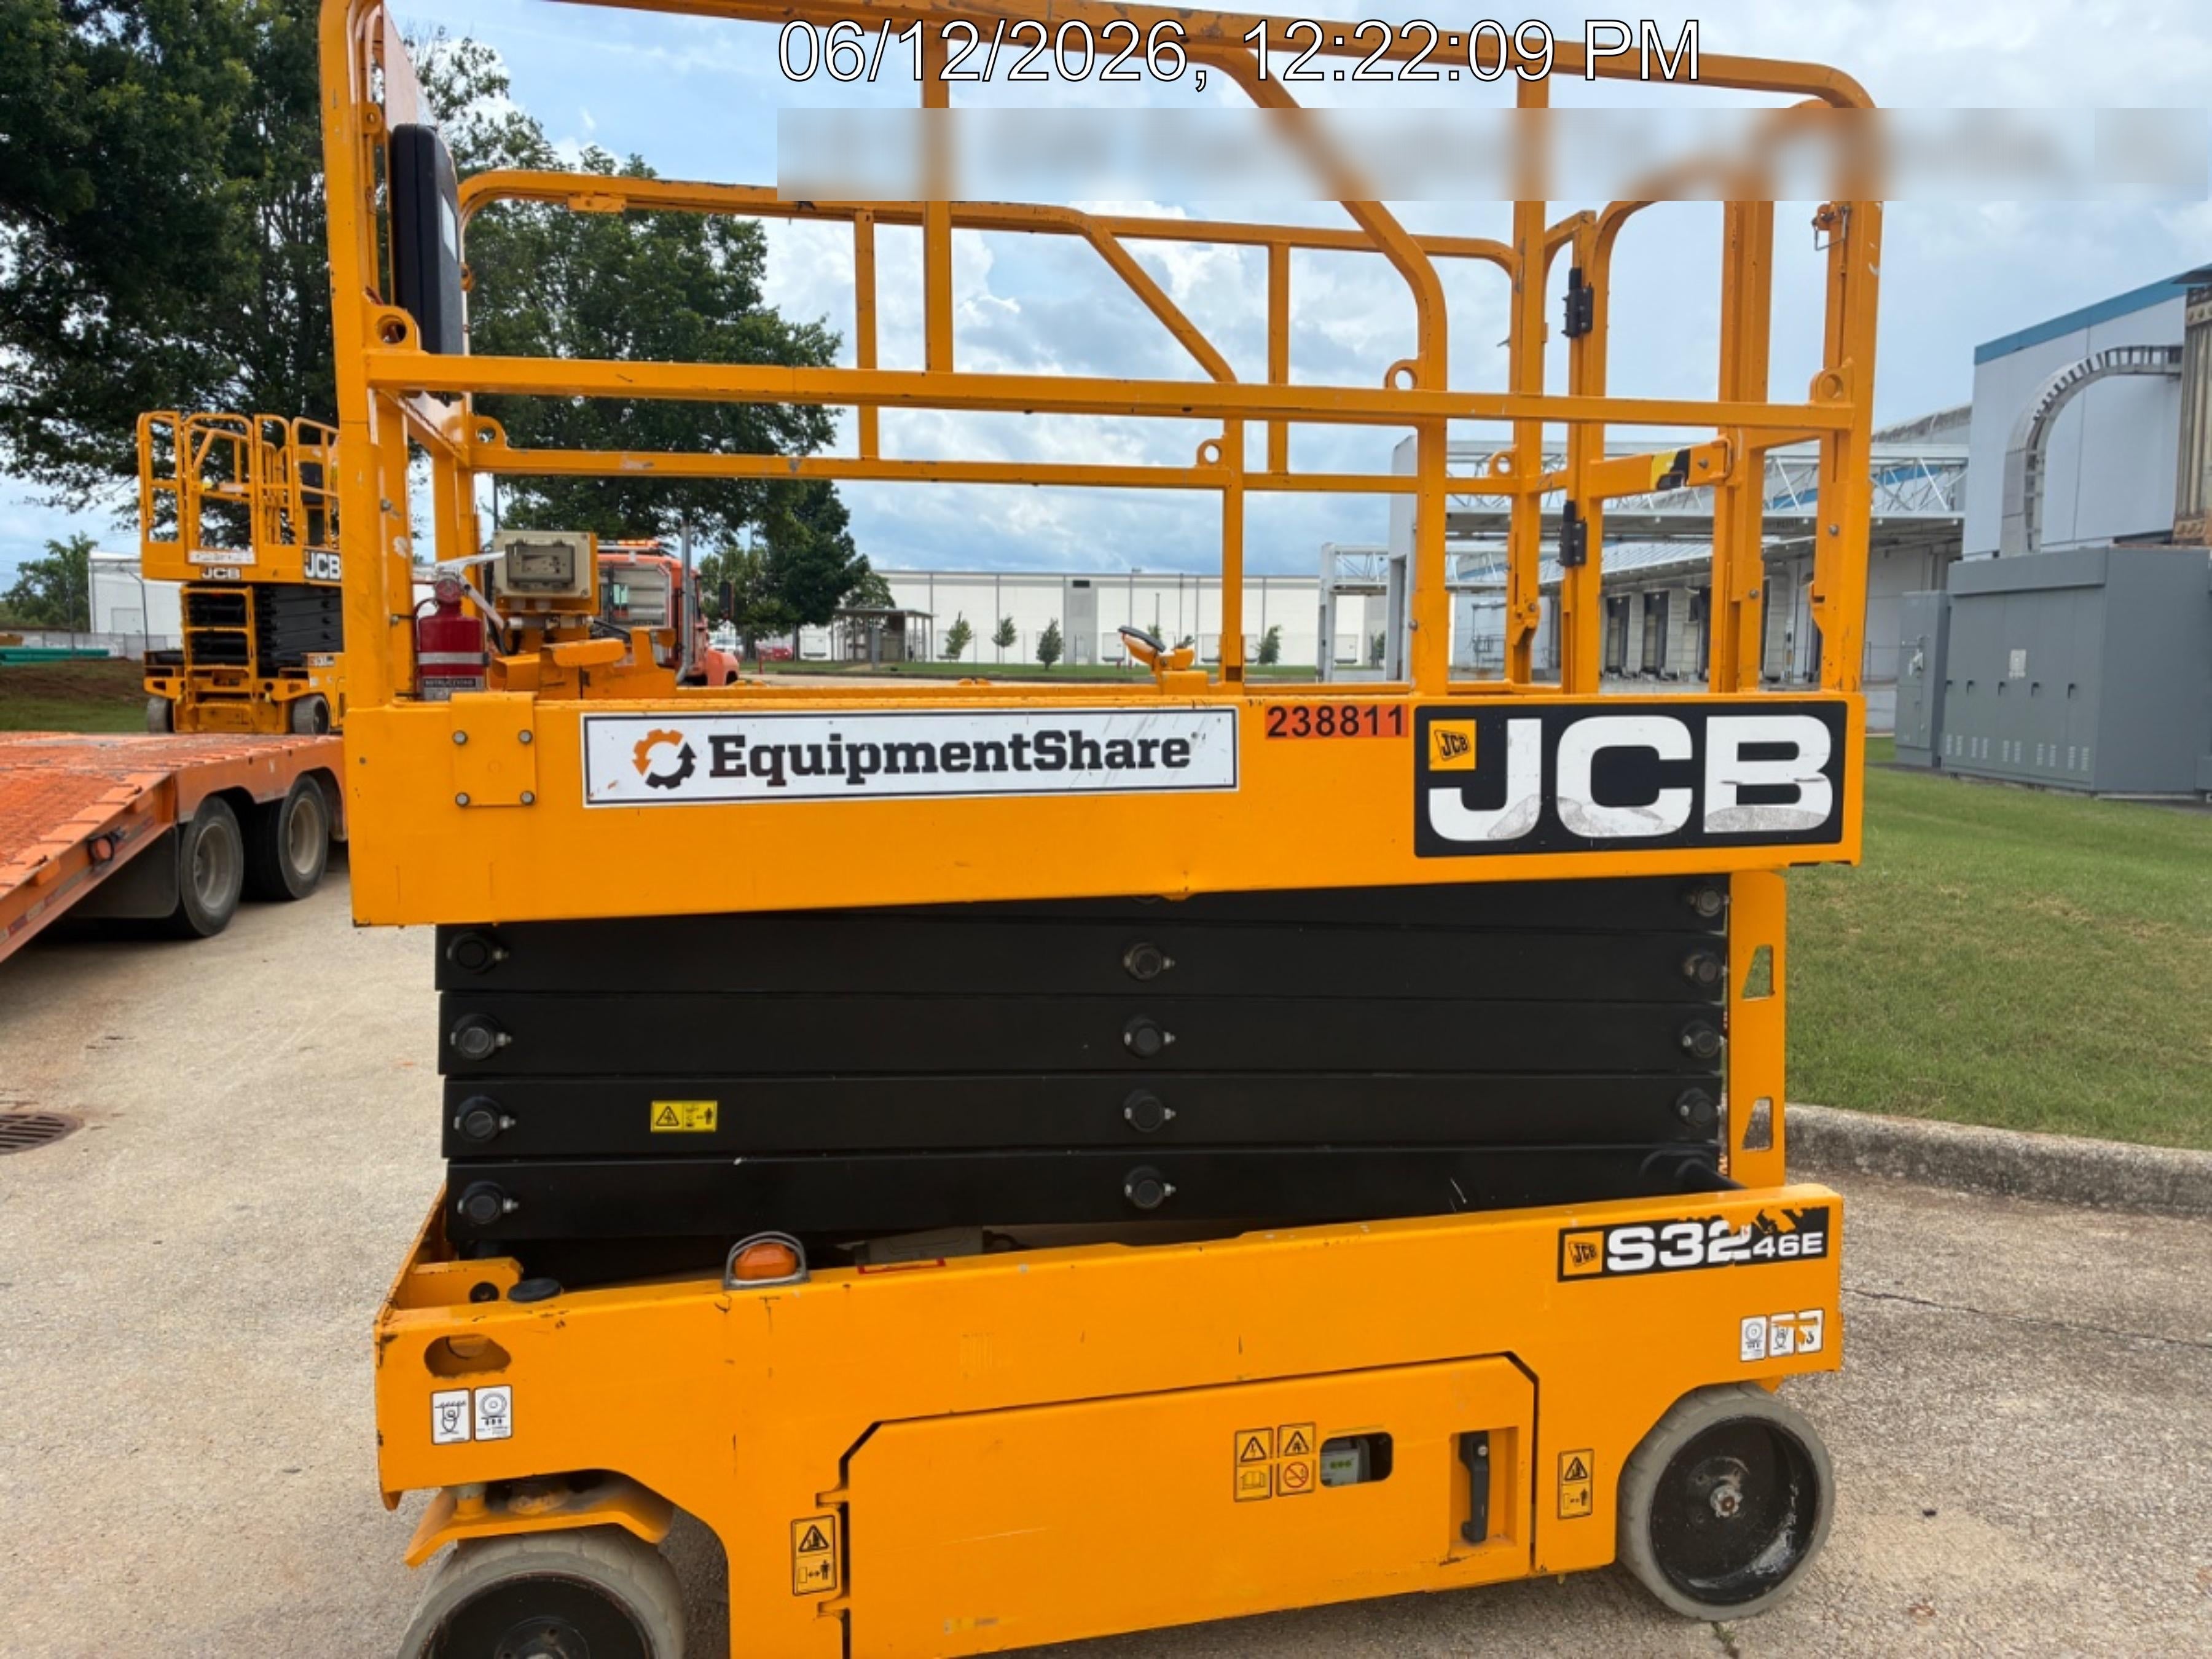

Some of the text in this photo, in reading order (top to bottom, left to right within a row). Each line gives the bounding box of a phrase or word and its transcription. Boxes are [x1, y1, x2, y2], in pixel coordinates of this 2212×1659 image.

[305, 551, 340, 579] JCB
[1268, 705, 1402, 737] 238811
[708, 731, 1191, 787] EquipmentShare
[1439, 732, 1469, 757] JCB
[1429, 715, 1834, 841] JCB
[1572, 1244, 1597, 1264] JCB
